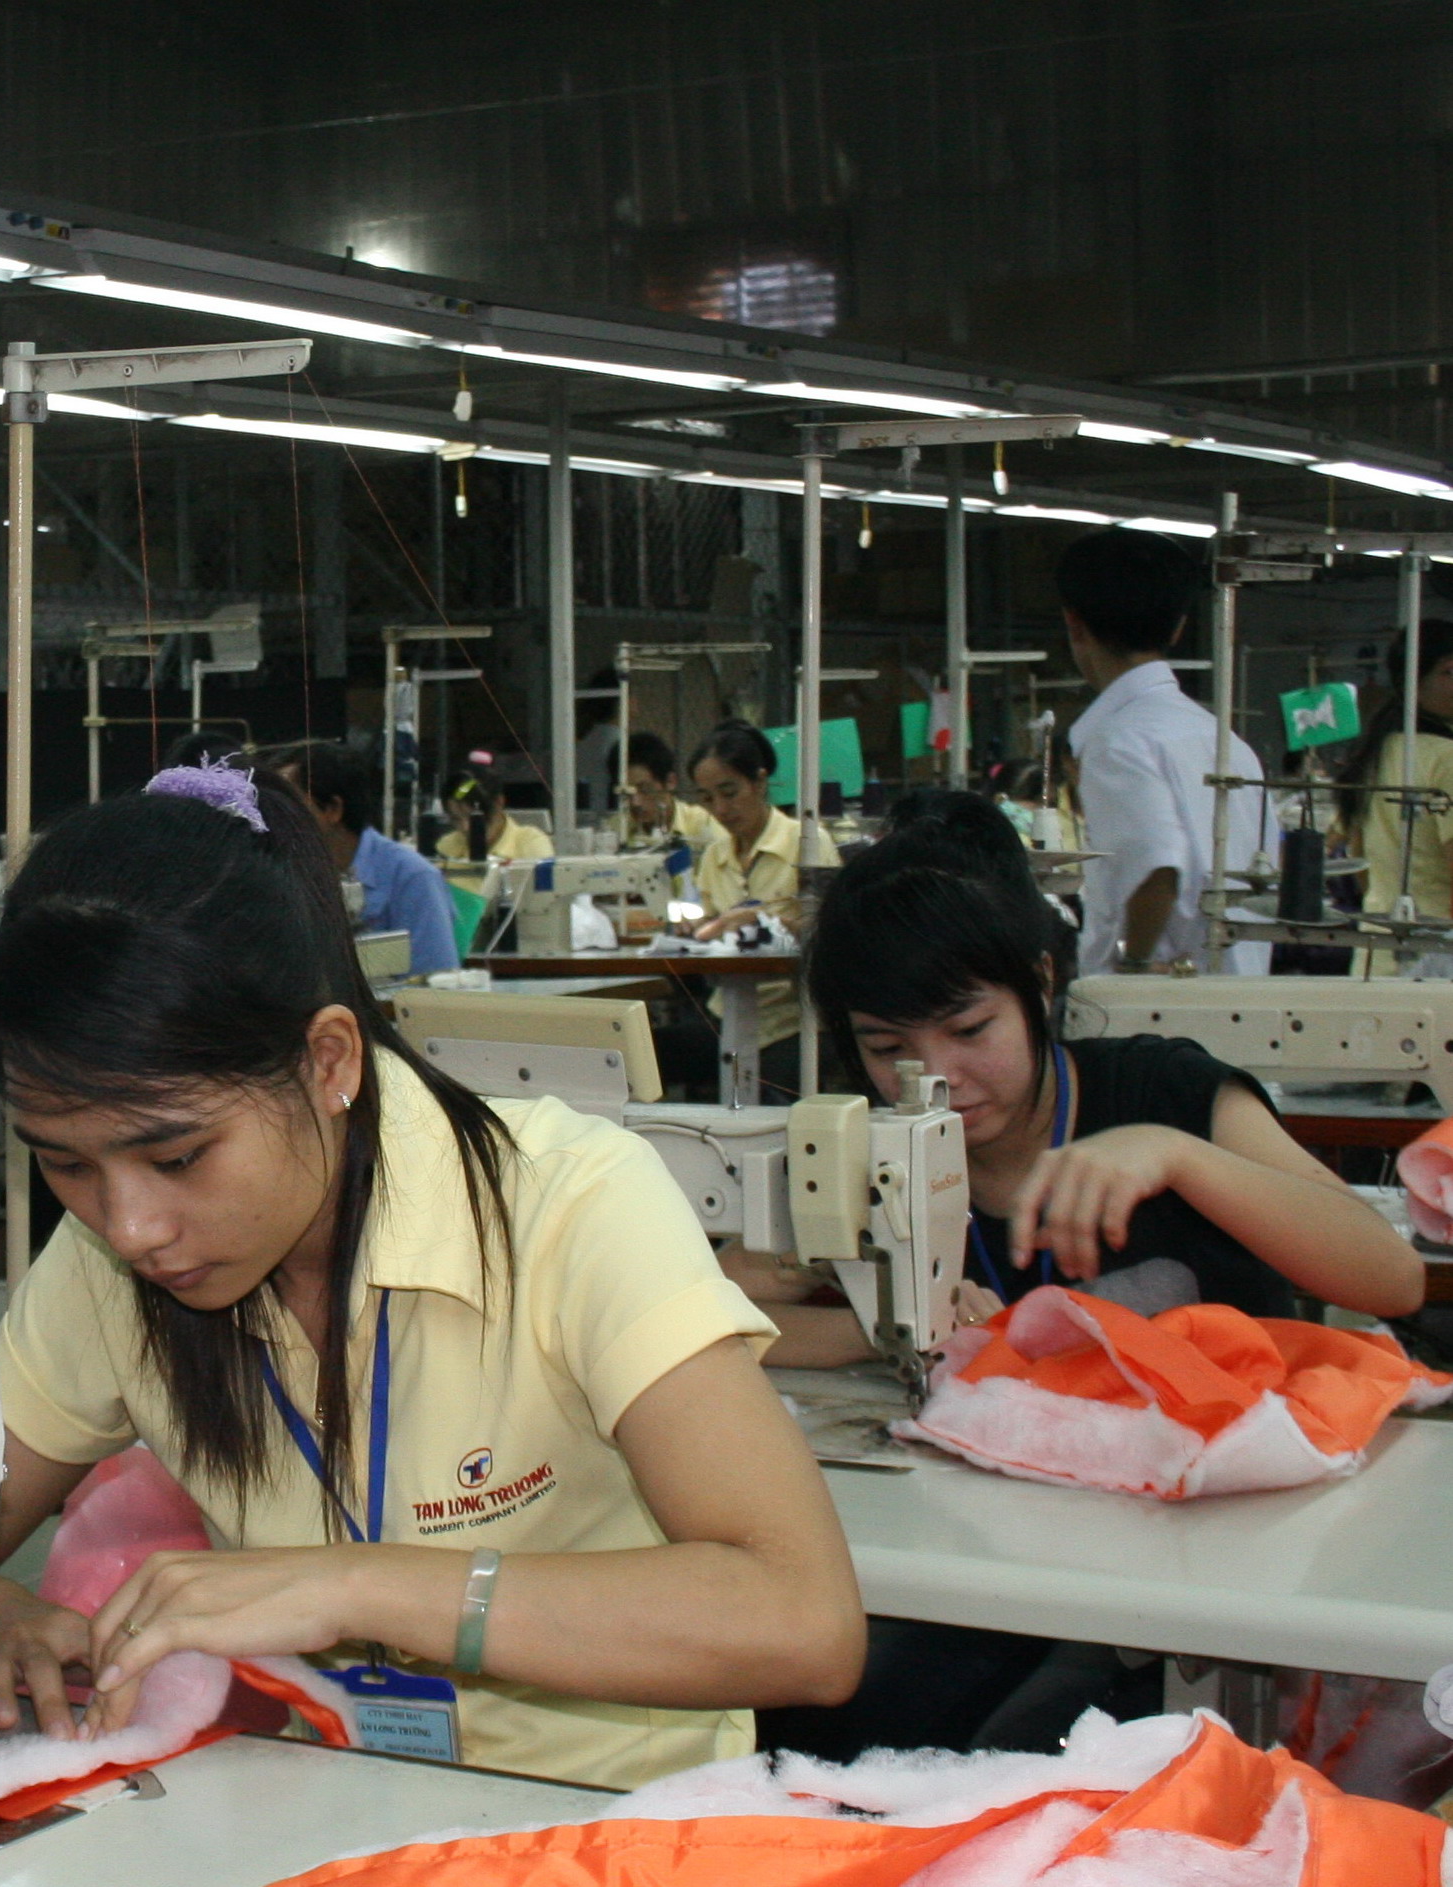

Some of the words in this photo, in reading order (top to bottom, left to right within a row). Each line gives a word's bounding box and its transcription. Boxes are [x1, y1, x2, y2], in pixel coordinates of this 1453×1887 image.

[412, 1500, 445, 1521] TAN
[448, 1495, 486, 1517] LONG
[485, 1462, 554, 1507] TRUONG
[419, 1521, 465, 1536] GARMENT
[468, 1505, 517, 1527] COMPANY
[520, 1480, 557, 1508] LIMITED
